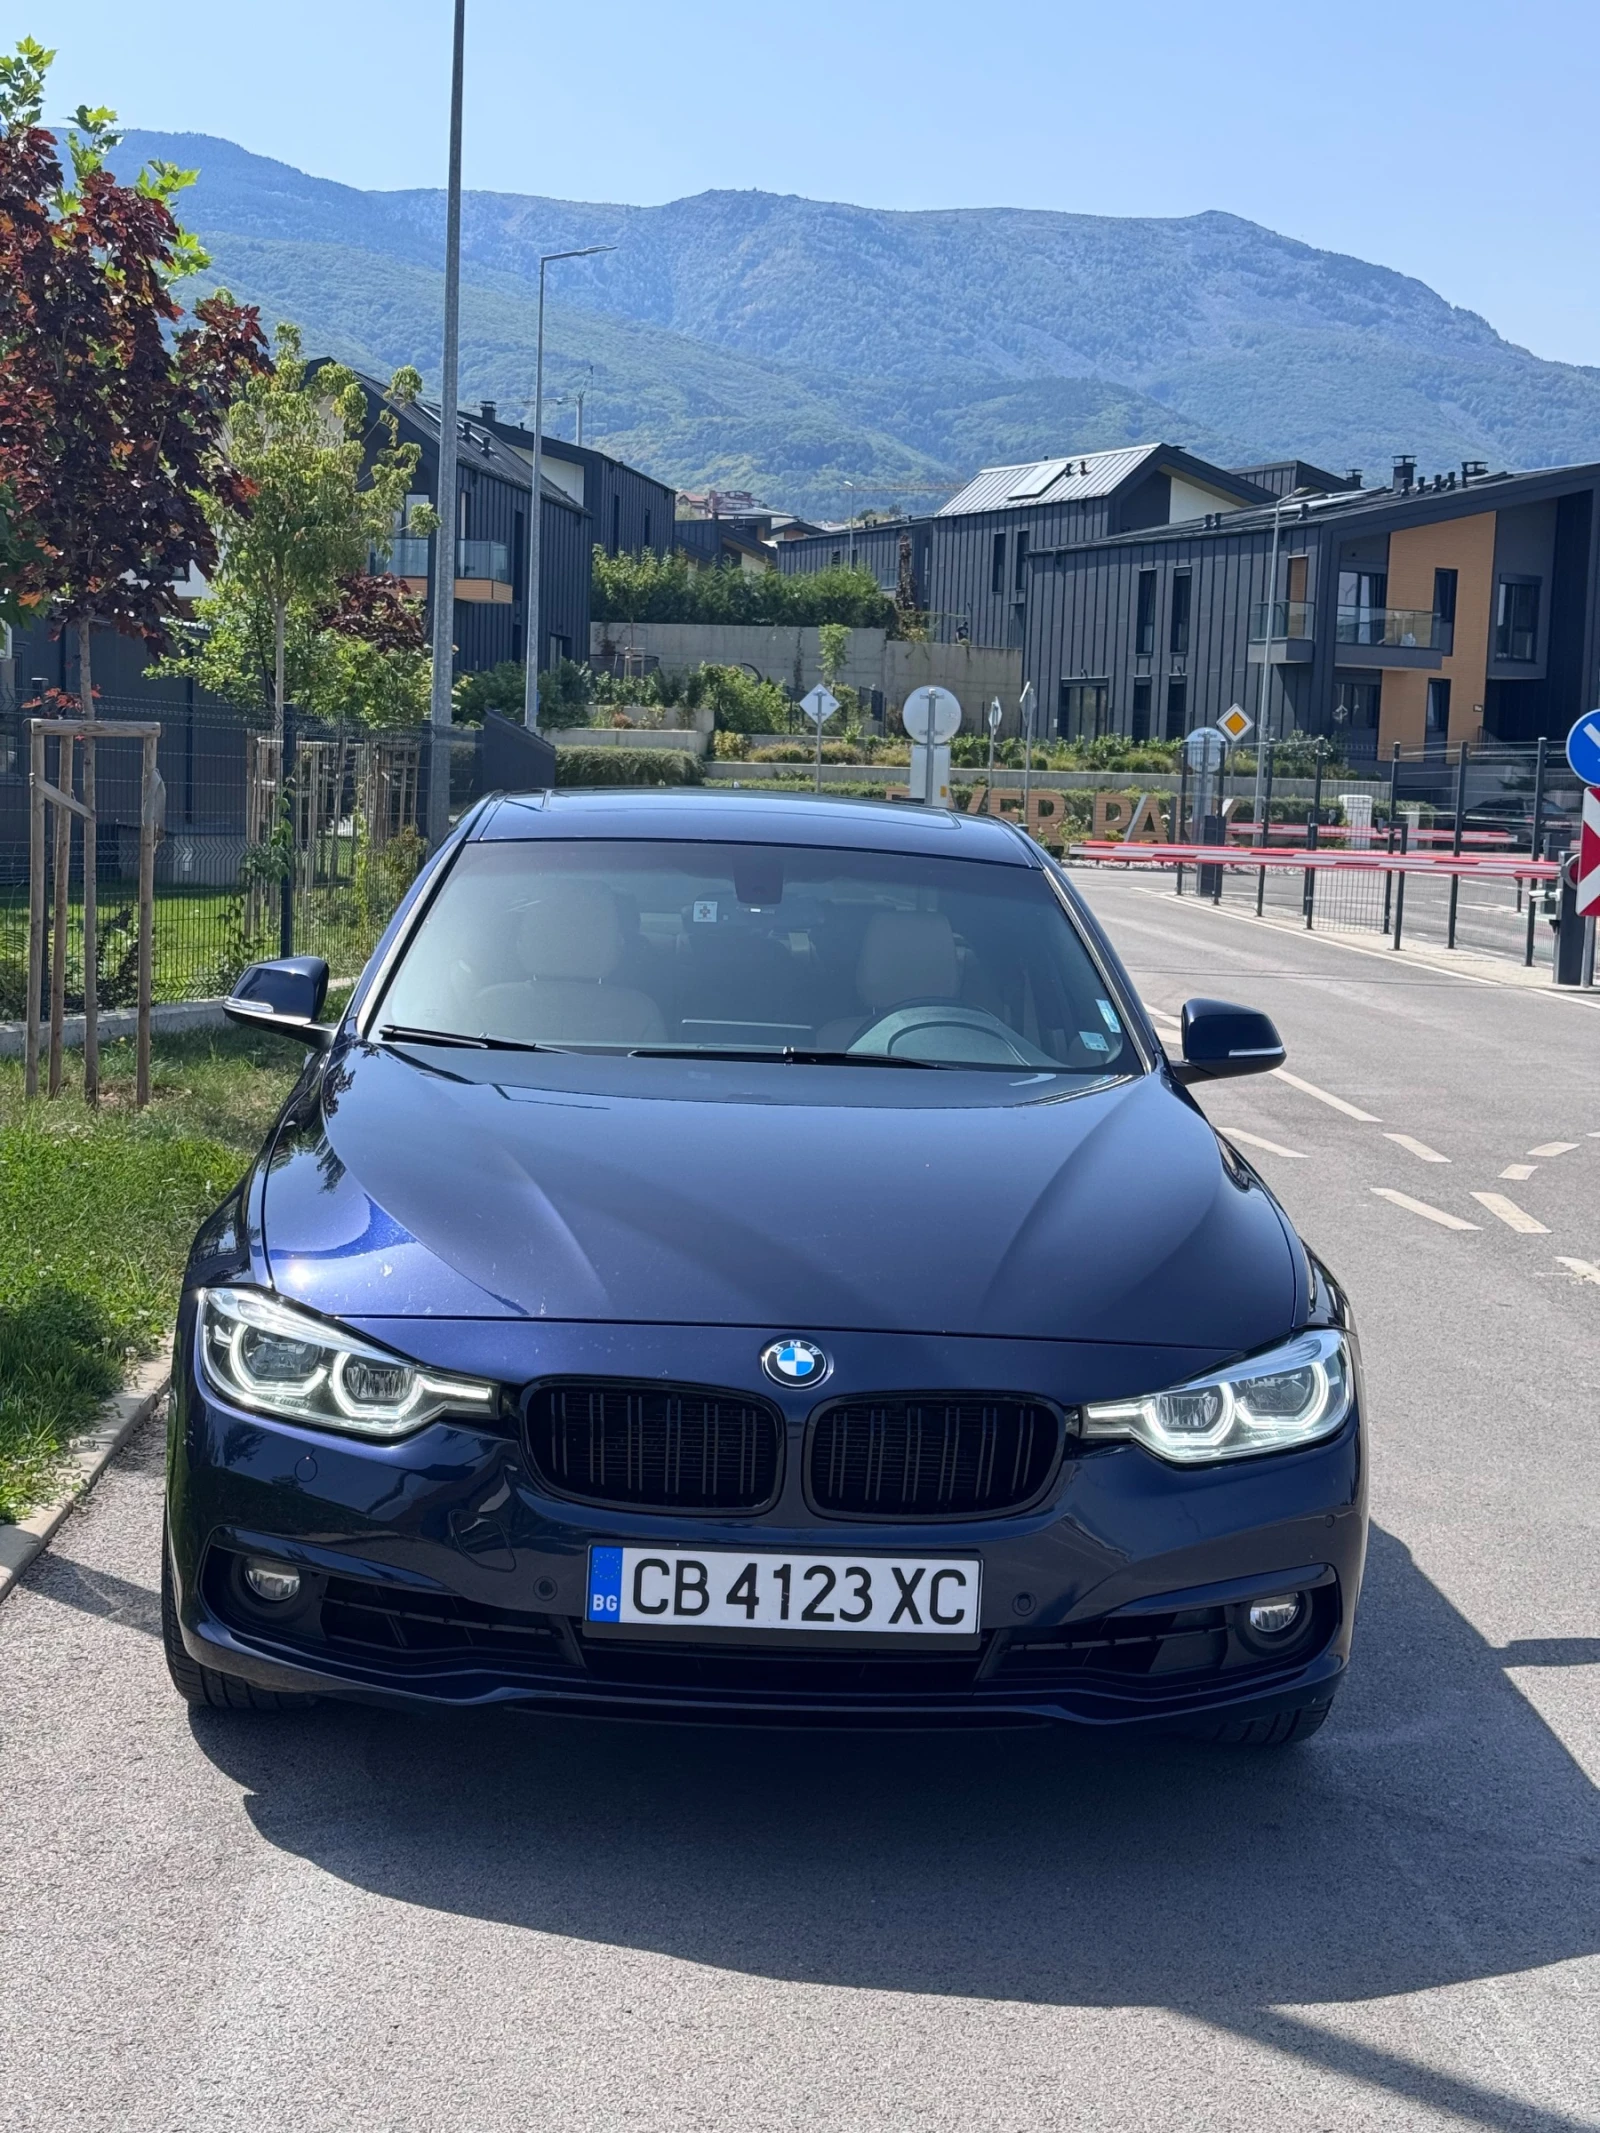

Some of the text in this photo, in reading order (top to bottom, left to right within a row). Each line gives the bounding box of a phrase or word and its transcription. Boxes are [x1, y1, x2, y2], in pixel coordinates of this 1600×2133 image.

[770, 1341, 821, 1356] BMW
[633, 1558, 967, 1626] CB 4123 XC
[593, 1594, 618, 1612] BG
